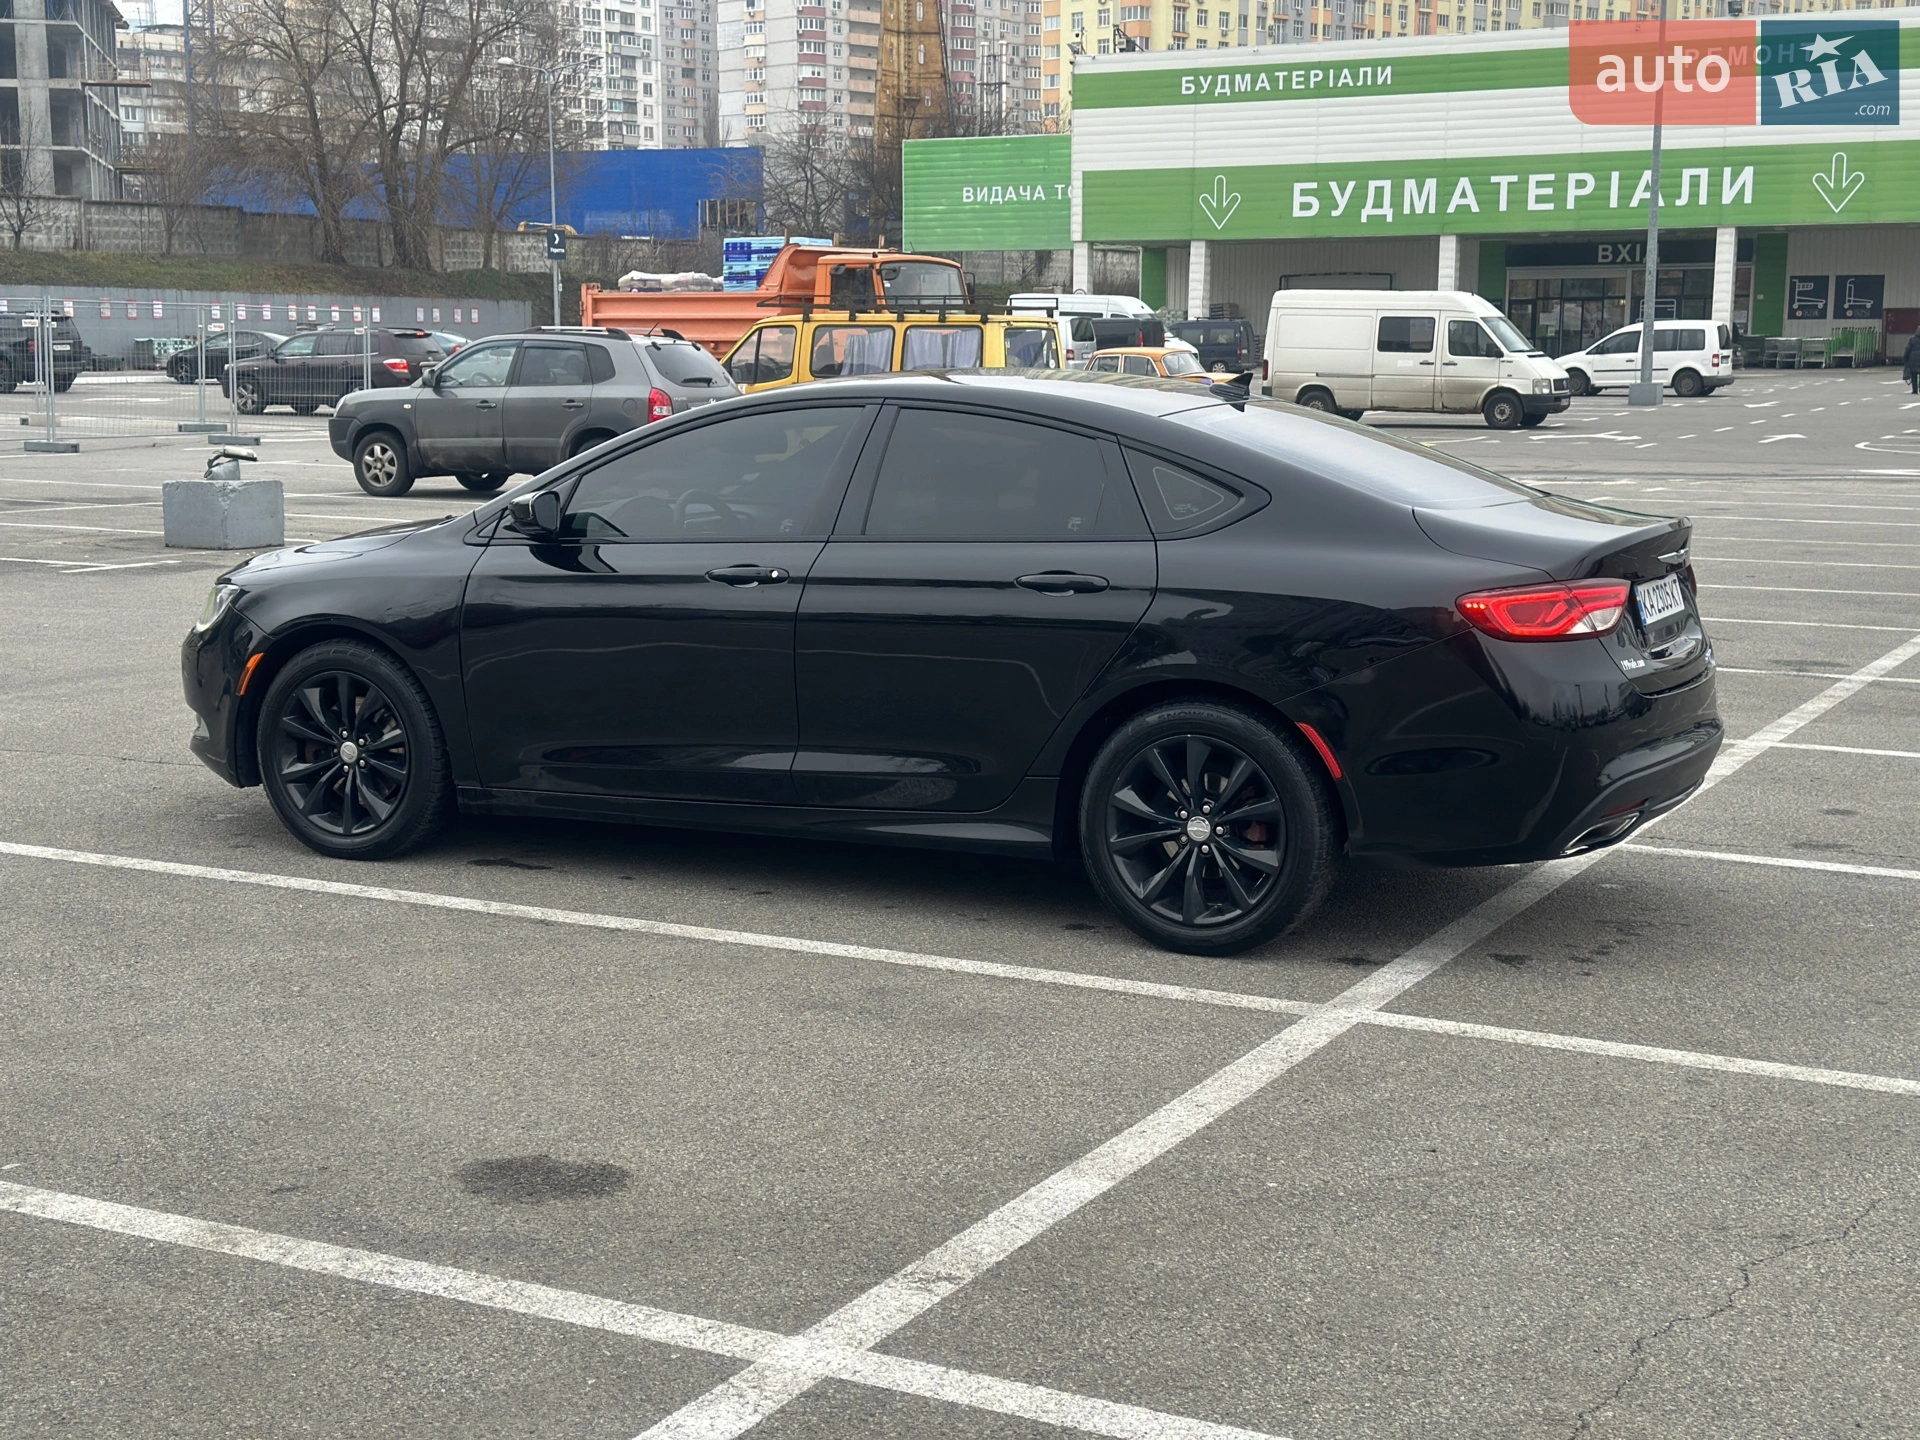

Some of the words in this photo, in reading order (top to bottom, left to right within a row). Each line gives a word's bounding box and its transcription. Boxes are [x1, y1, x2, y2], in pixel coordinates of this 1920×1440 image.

[1181, 65, 1392, 97] БУДМАТЕРІАЛИ
[962, 185, 1046, 204] ВИДАЧА
[1292, 166, 1755, 223] БУДМАТЕРІАЛИ
